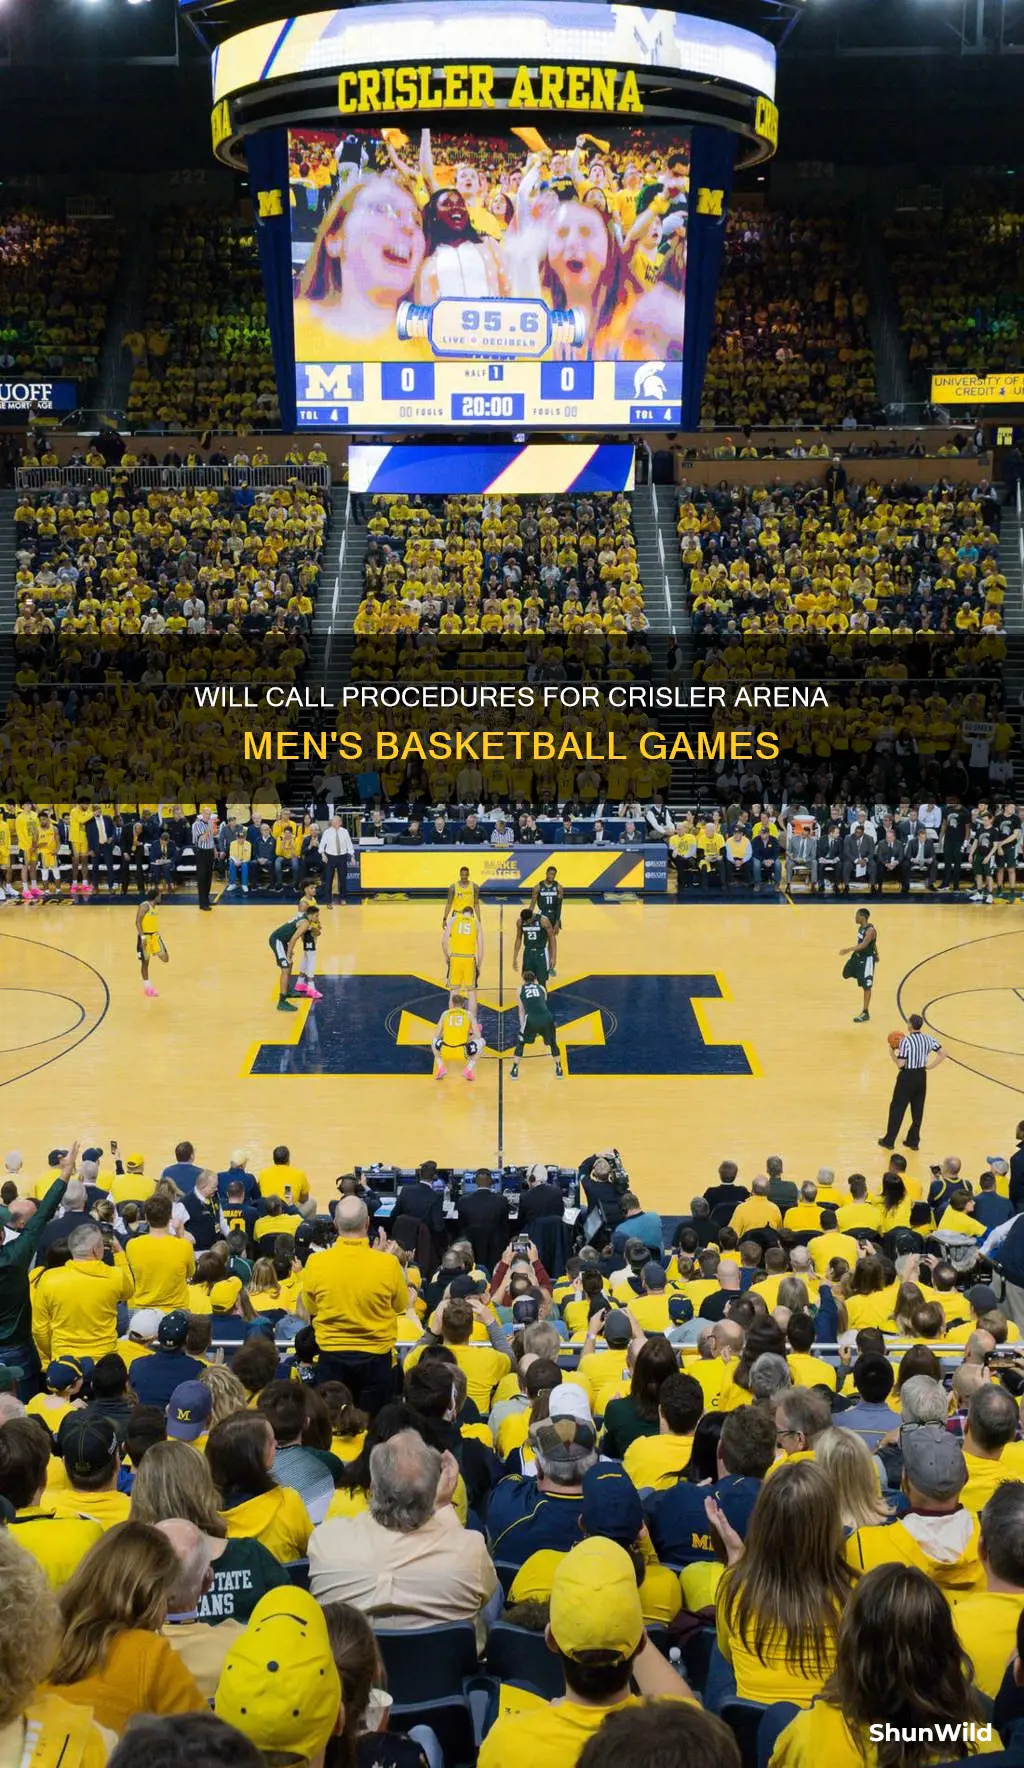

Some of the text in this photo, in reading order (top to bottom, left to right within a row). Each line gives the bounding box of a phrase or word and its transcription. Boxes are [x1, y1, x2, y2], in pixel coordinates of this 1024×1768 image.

[338, 65, 644, 113] CRISLER ARENA
[461, 310, 539, 333] 95.6
[401, 367, 415, 392] 0
[561, 367, 575, 392] 0
[955, 387, 994, 397] CREDIT
[8, 401, 53, 409] MORTAGE
[462, 396, 513, 417] 20:00
[330, 409, 339, 421] 4
[663, 408, 672, 421] 4
[527, 931, 537, 940] 23
[525, 988, 540, 998] 20
[176, 1408, 192, 1421] M
[208, 1568, 253, 1592] TATE
